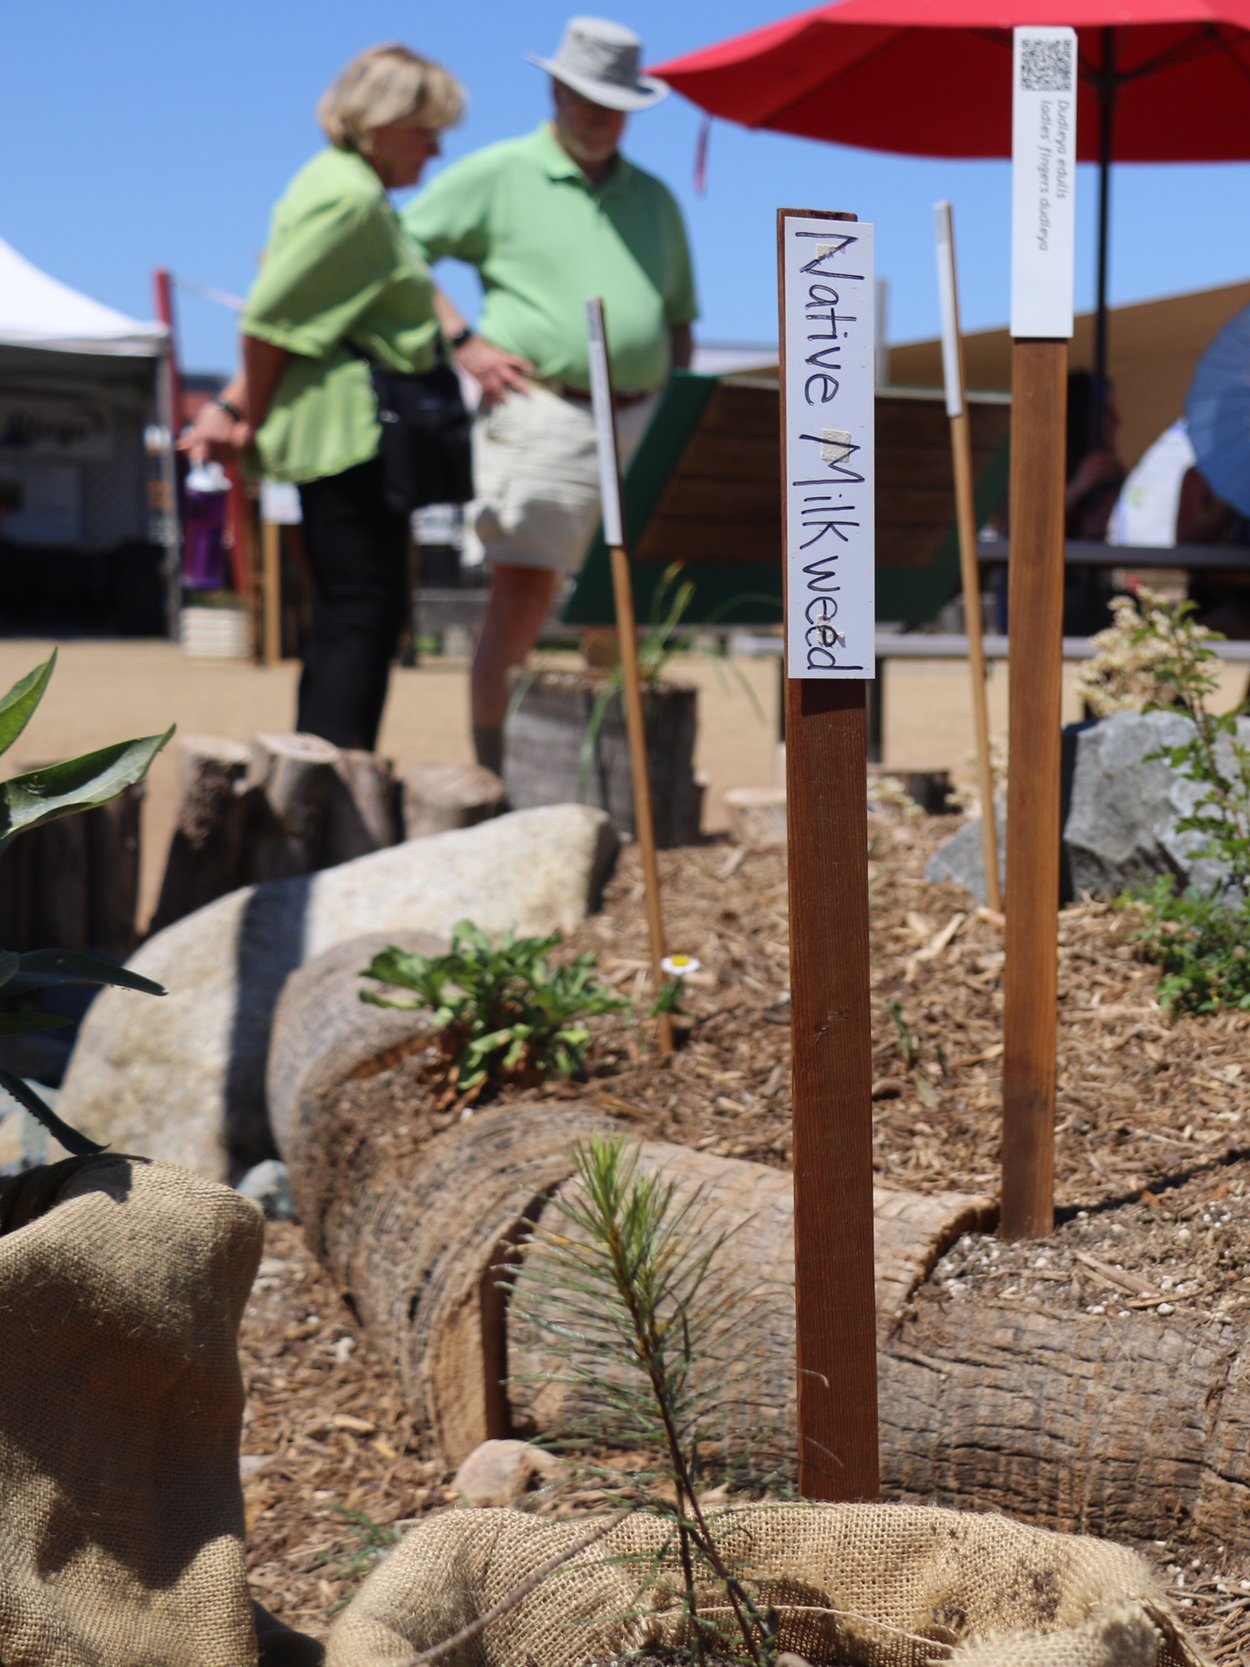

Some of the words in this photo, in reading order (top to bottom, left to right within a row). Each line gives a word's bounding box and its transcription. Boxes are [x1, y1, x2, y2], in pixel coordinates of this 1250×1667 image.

[1056, 99, 1070, 155] Dudleya
[1038, 145, 1052, 194] fingers
[1056, 158, 1070, 199] edulis
[1038, 197, 1051, 251] dudleya
[795, 232, 865, 406] Native
